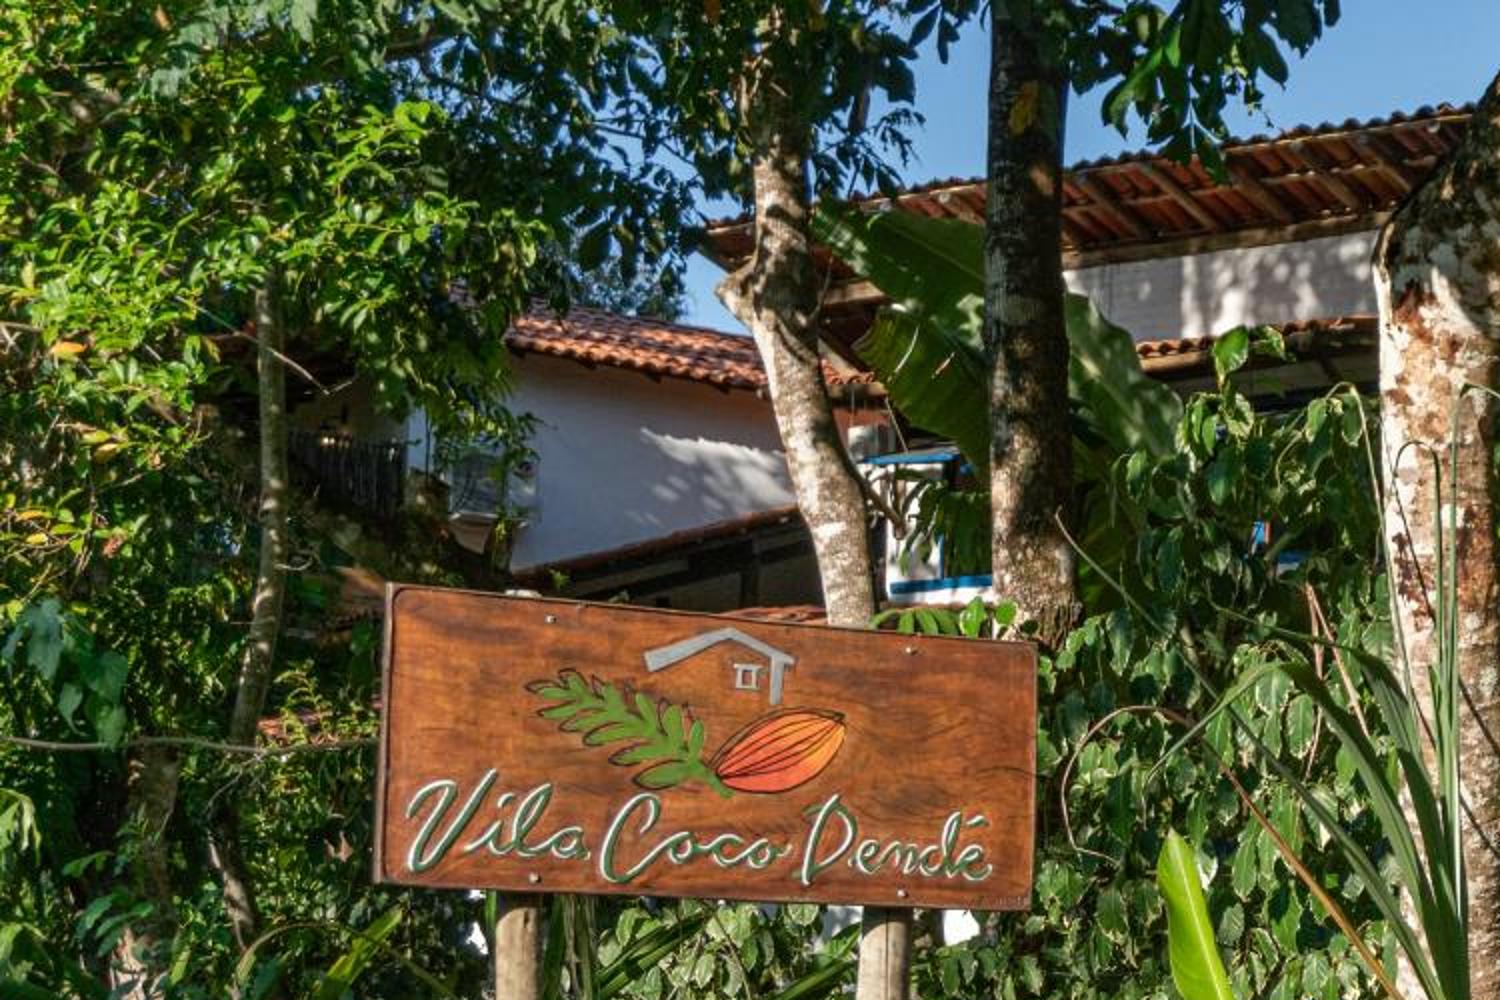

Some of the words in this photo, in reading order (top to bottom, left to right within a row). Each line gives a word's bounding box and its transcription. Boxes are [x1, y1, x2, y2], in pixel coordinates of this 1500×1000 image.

[405, 767, 591, 873] Vila
[599, 792, 792, 884] Coco
[796, 793, 993, 885] Dendé
